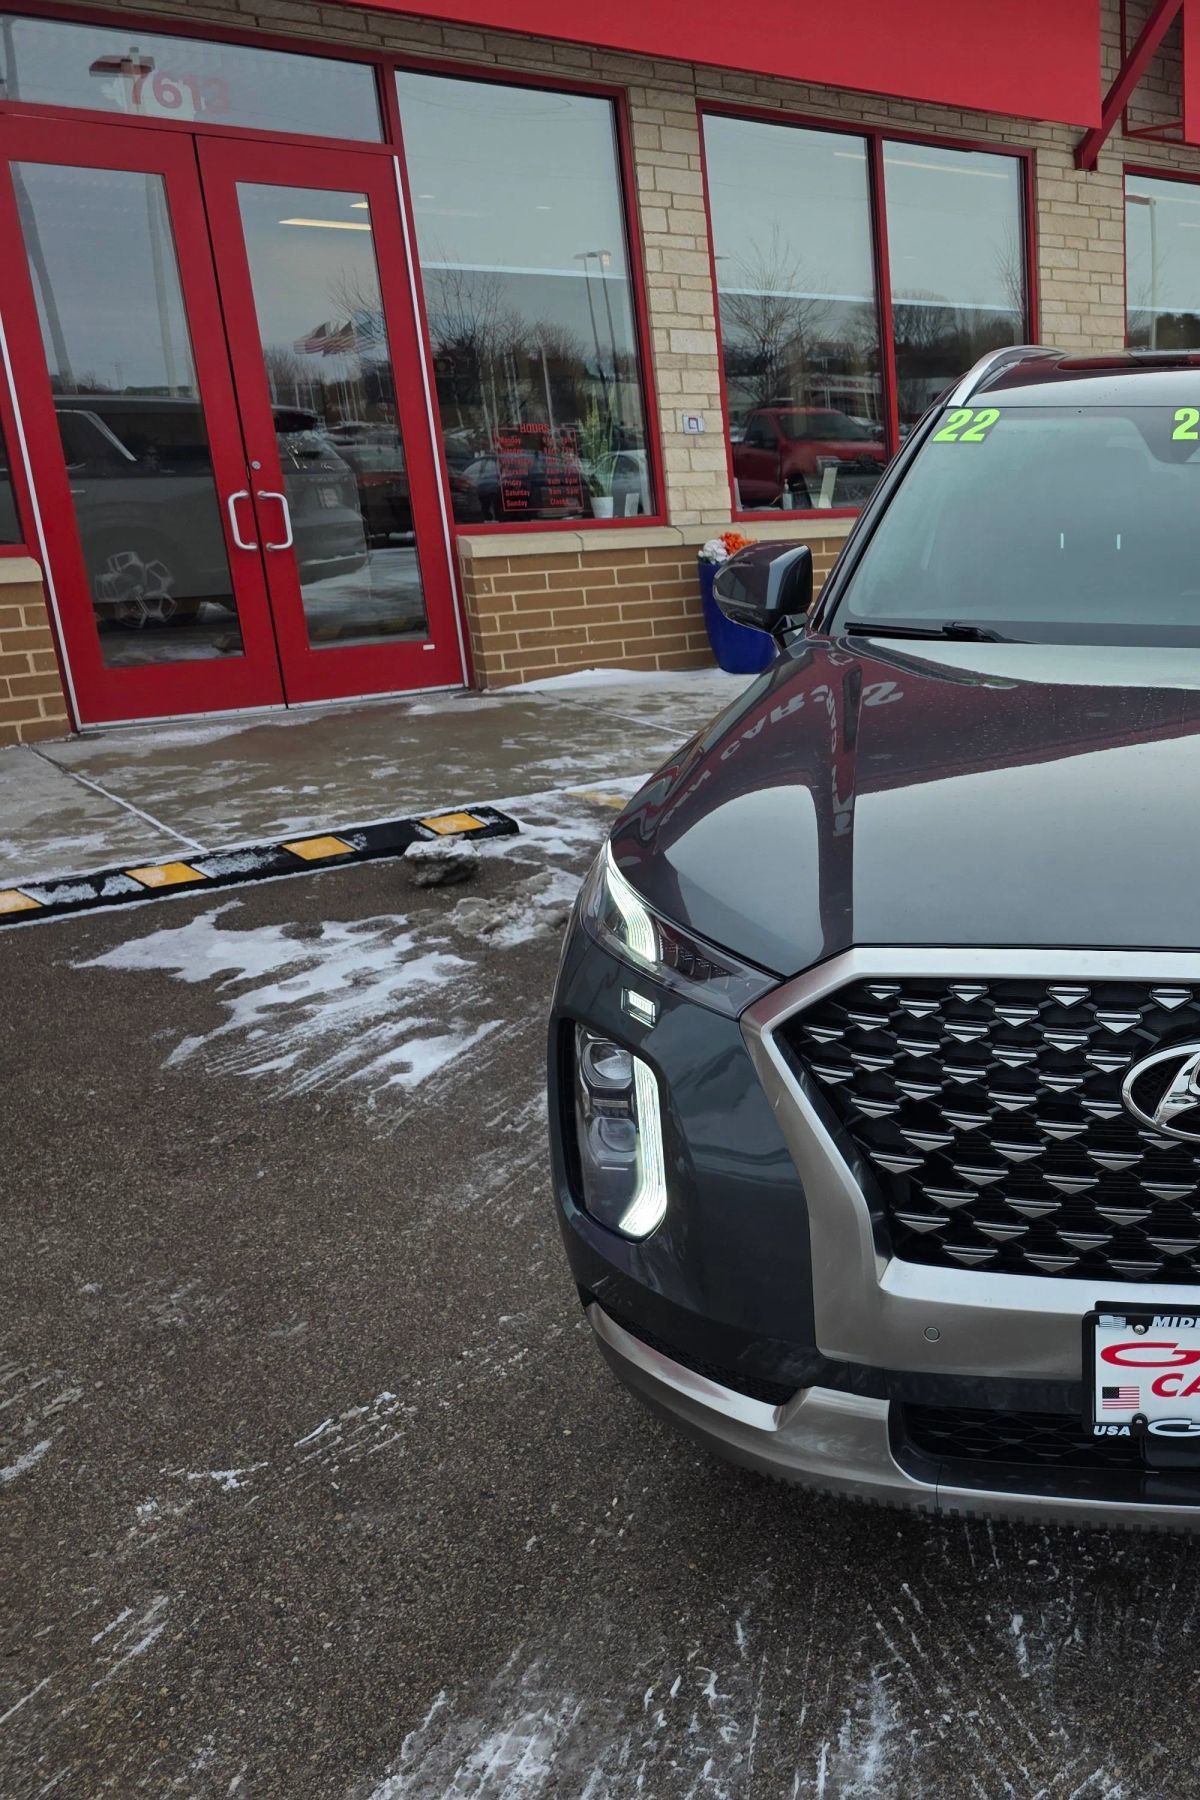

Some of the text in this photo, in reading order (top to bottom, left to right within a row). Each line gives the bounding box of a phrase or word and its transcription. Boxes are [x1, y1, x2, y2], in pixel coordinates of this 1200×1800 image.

[520, 423, 549, 433] HOURS
[932, 409, 1000, 442] 22
[1093, 1425, 1131, 1436] USA
